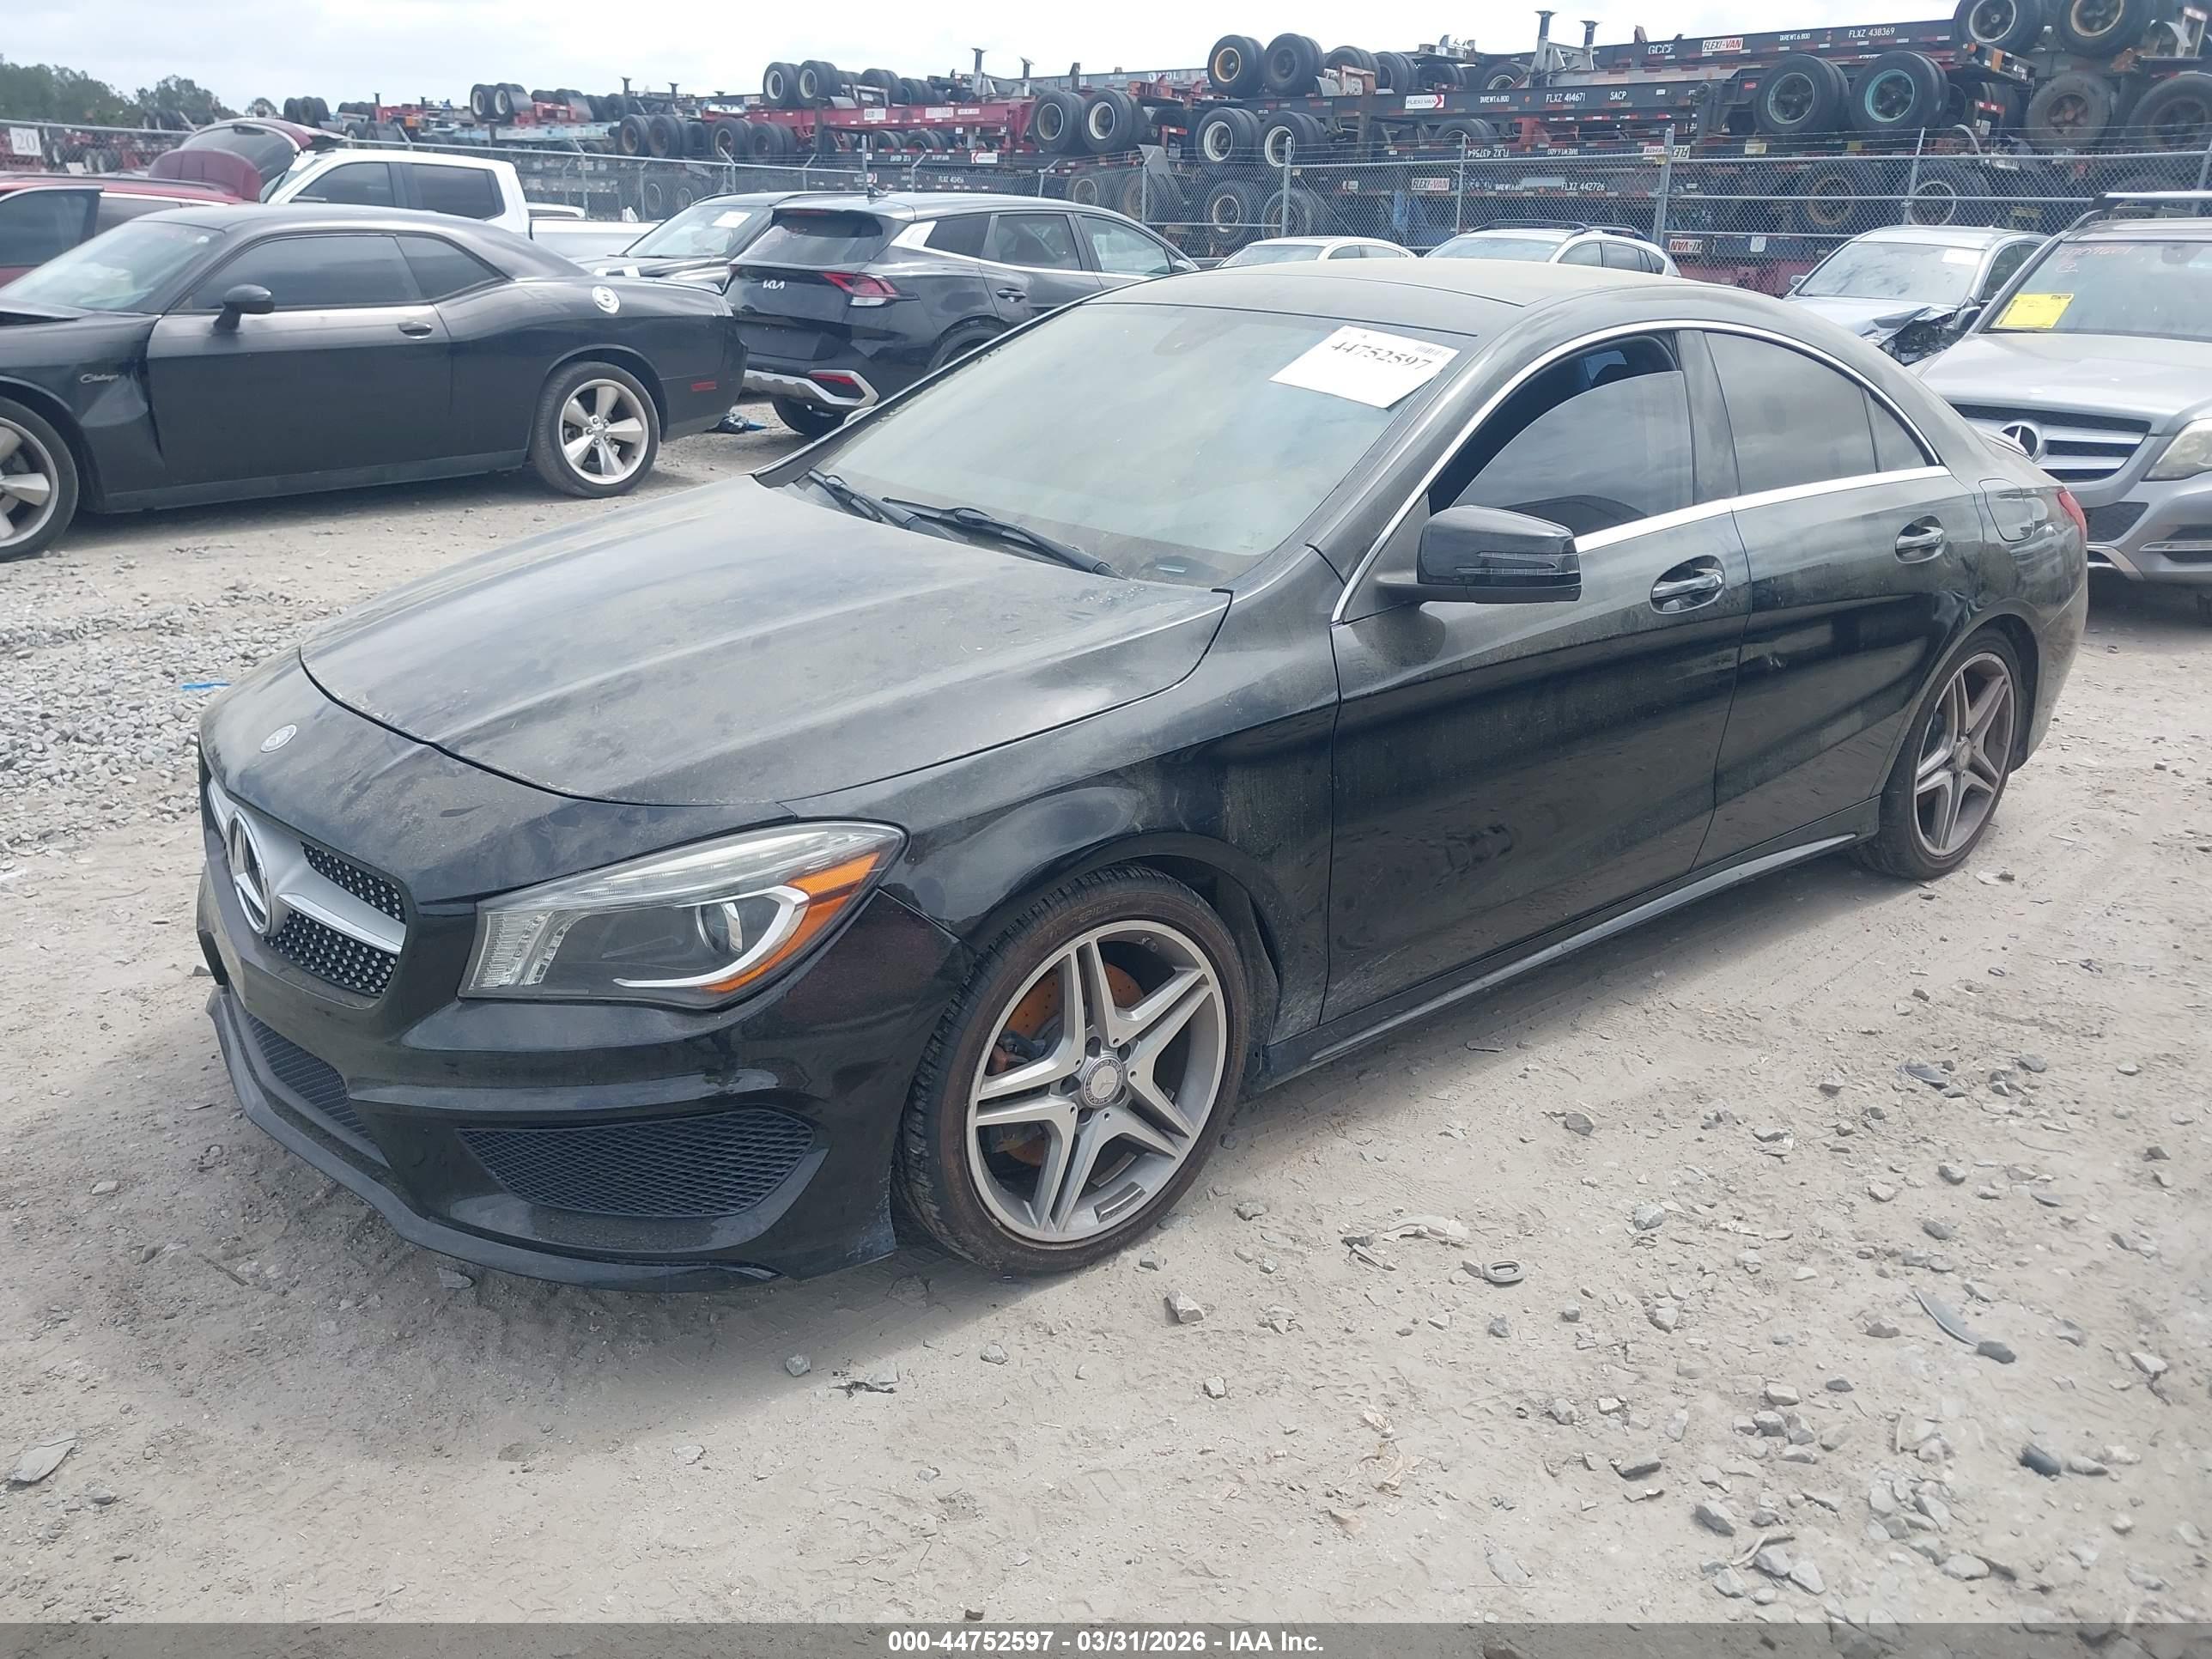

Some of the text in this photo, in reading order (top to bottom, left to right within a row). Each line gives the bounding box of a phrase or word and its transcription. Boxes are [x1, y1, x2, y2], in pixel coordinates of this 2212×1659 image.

[1849, 29, 1867, 39] FLXZ
[1703, 39, 1742, 51] FLEXI-VAN
[1546, 92, 1587, 103] FLXZ 414671
[1609, 90, 1628, 100] SACP
[16, 132, 36, 151] 20
[1413, 179, 1449, 189] FLEXI-VAN
[1561, 181, 1577, 191] FLXZ
[763, 279, 786, 289] KIA
[1332, 341, 1433, 370] 44752597
